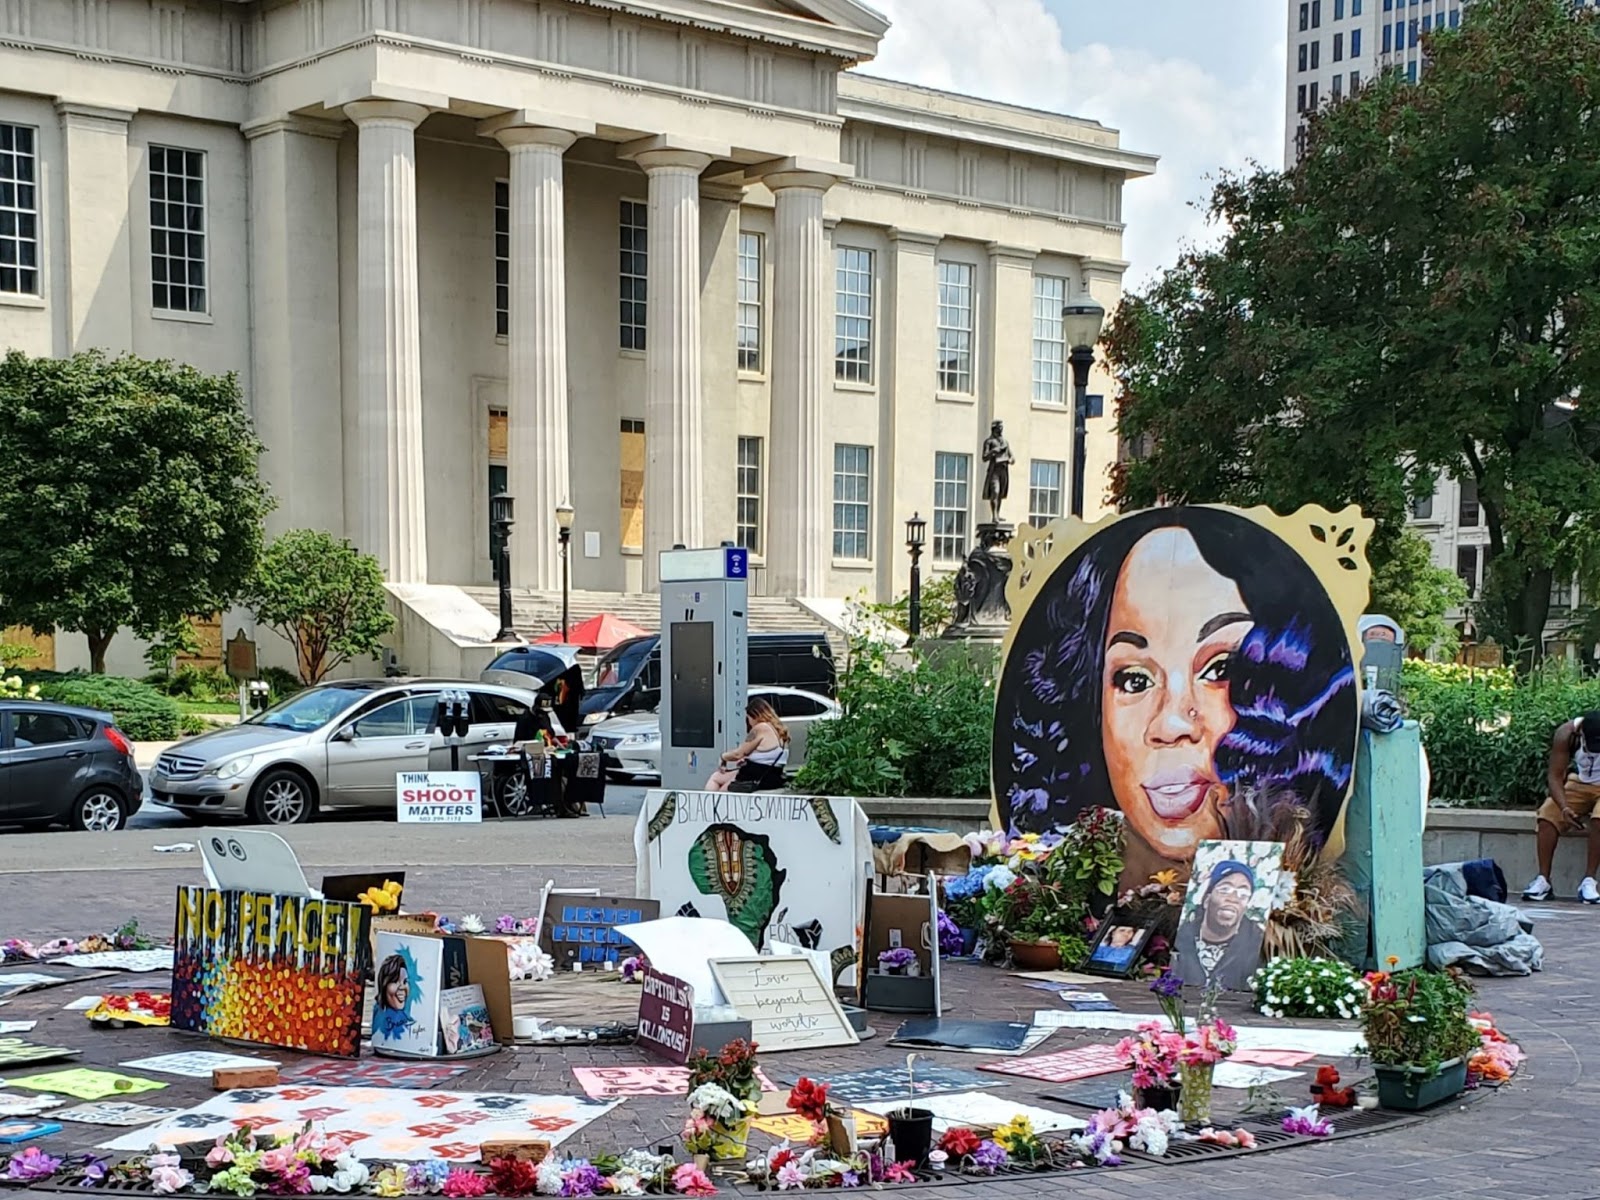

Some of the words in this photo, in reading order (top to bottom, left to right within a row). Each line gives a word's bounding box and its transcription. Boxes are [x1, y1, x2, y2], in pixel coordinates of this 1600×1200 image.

[402, 773, 430, 784] THINK
[402, 789, 477, 803] SHOOT
[408, 805, 474, 816] MATTERS
[677, 791, 722, 824] BLACK
[763, 796, 809, 822] MATTER
[178, 886, 226, 939] NO
[239, 891, 362, 957] PEACE!
[748, 967, 790, 988] Love
[753, 989, 812, 1015] beyond
[661, 1005, 671, 1022] IS
[769, 1013, 819, 1032] words
